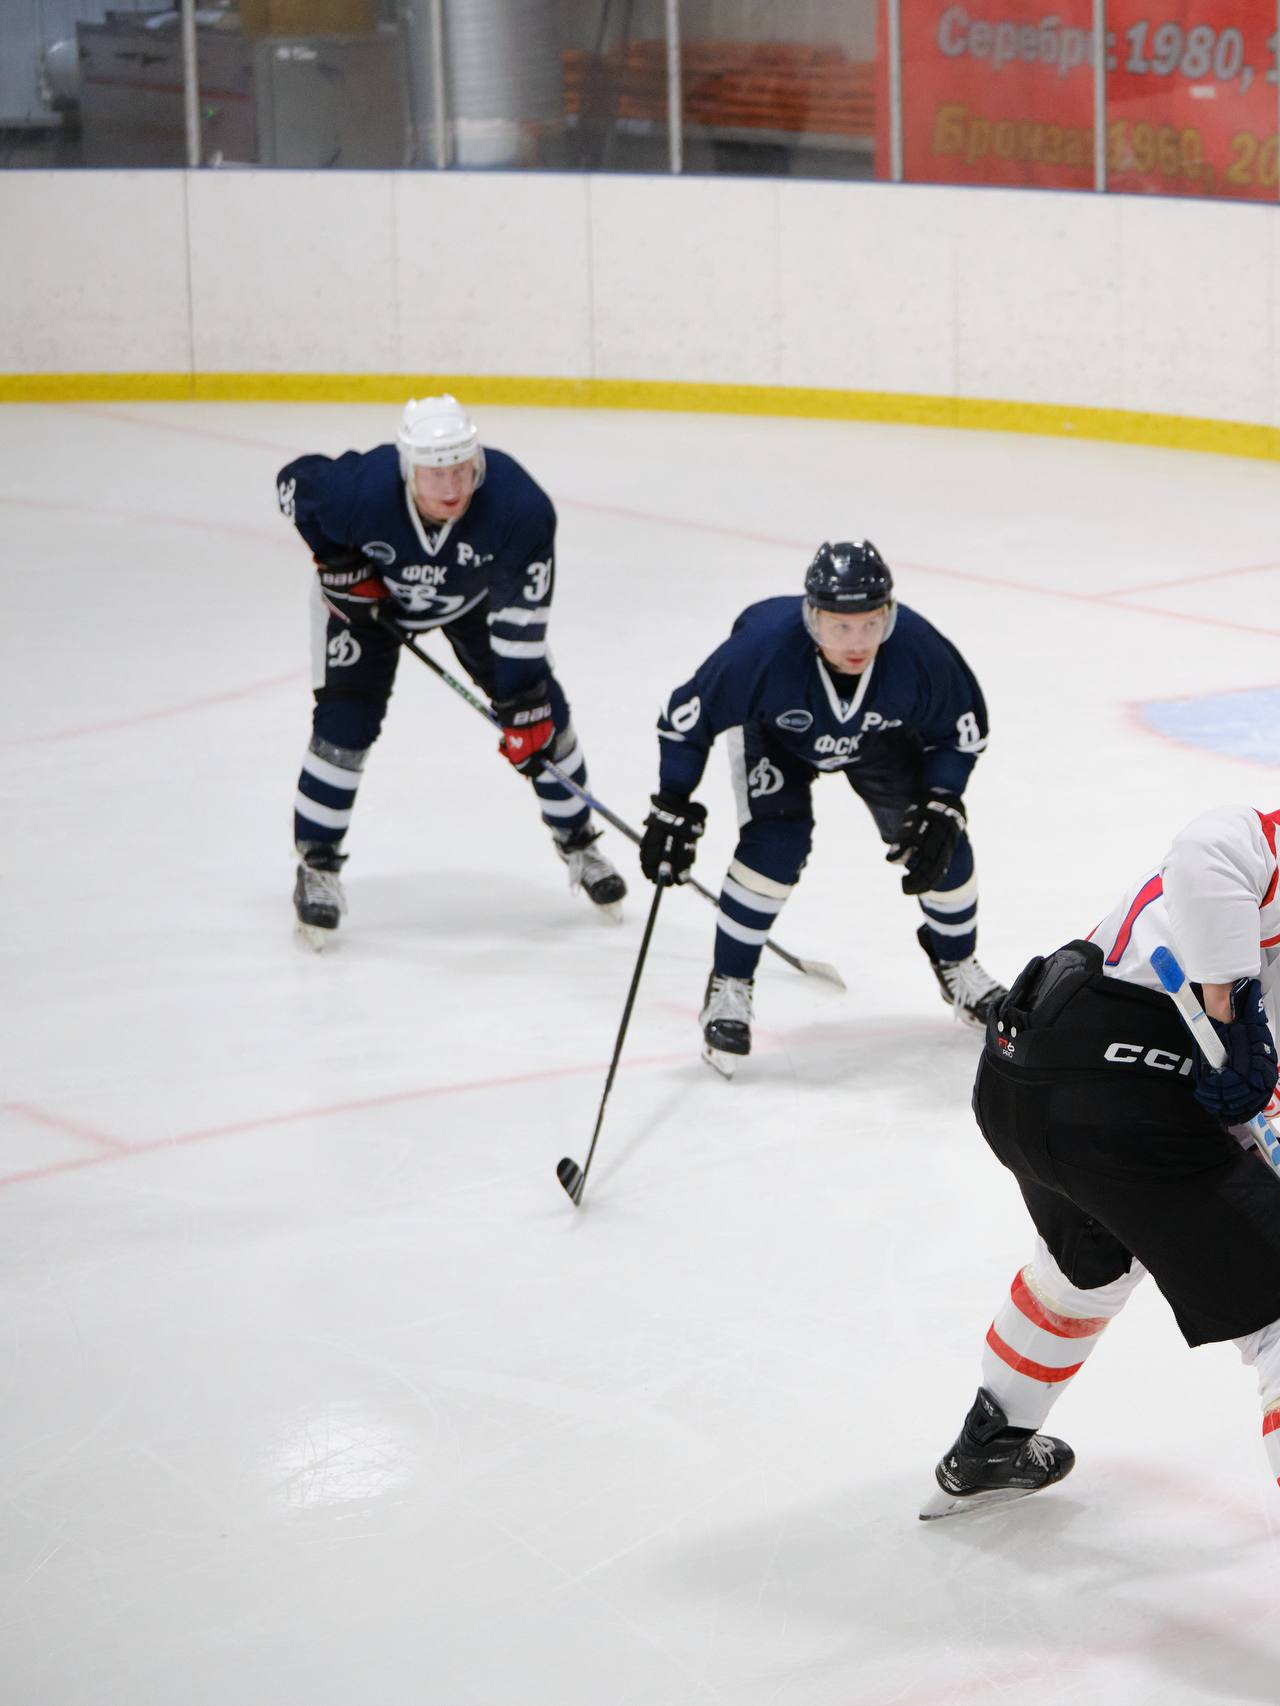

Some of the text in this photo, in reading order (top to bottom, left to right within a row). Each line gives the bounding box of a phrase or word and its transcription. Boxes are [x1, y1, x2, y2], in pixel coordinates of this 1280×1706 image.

[1124, 20, 1255, 97] 1980,
[401, 564, 447, 586] ФСК
[523, 558, 553, 603] 3
[814, 733, 864, 756] ФСК
